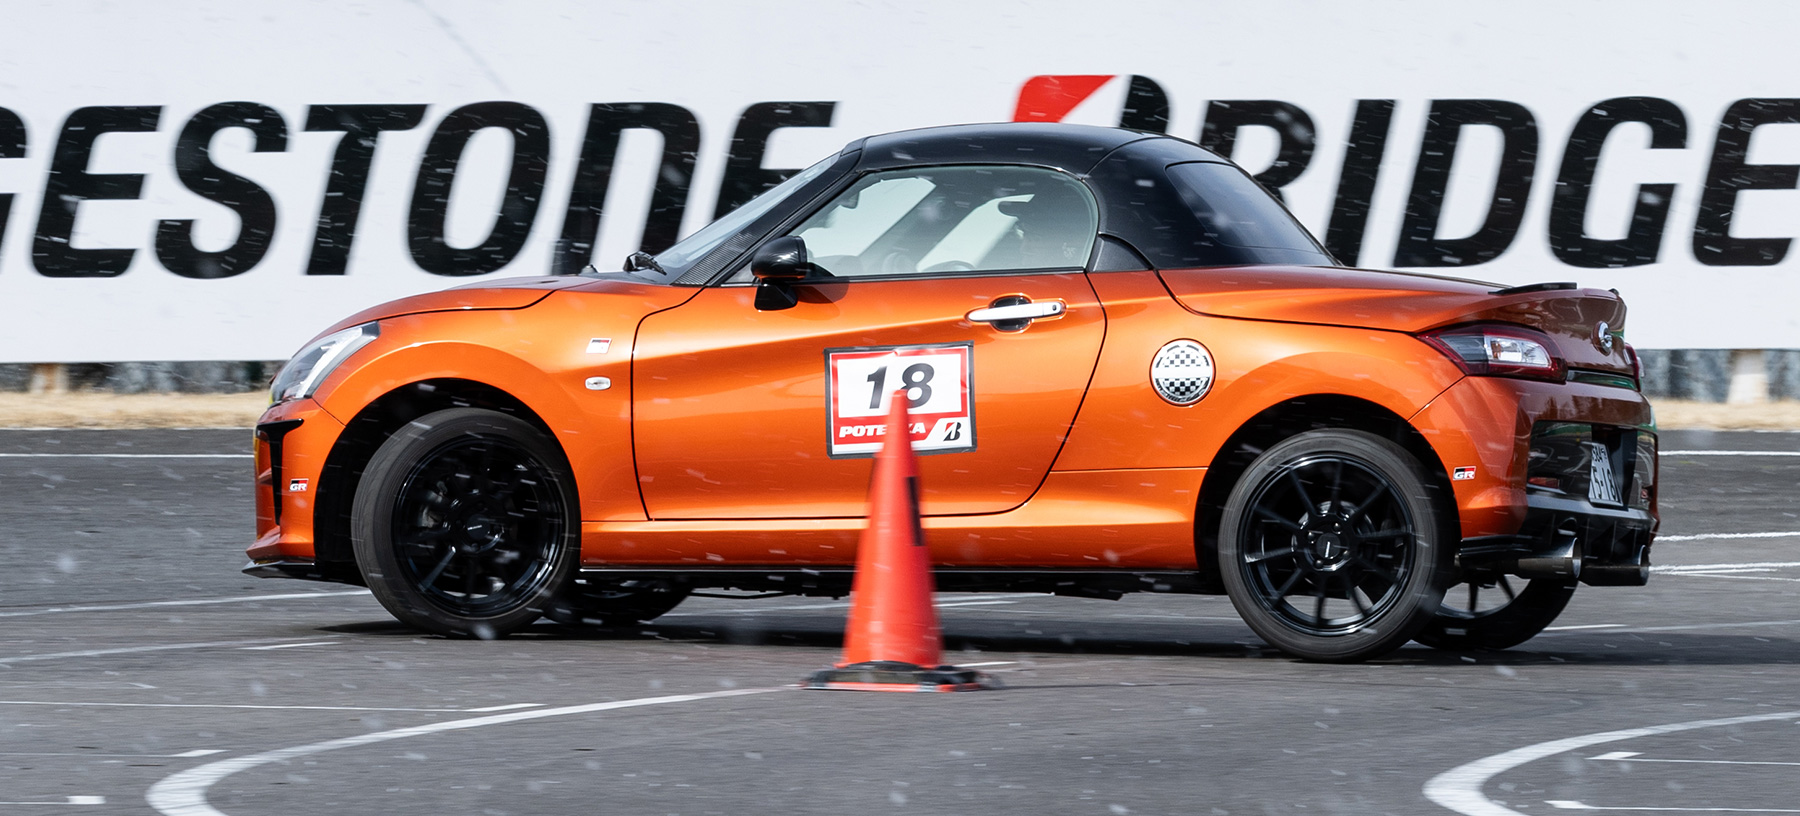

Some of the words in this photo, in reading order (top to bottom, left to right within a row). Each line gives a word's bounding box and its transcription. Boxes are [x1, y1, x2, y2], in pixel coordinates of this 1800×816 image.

[0, 100, 839, 279] ESTONE
[866, 362, 935, 409] 18
[838, 422, 926, 438] POTEA
[1453, 470, 1475, 480] GR
[289, 482, 308, 491] GR
